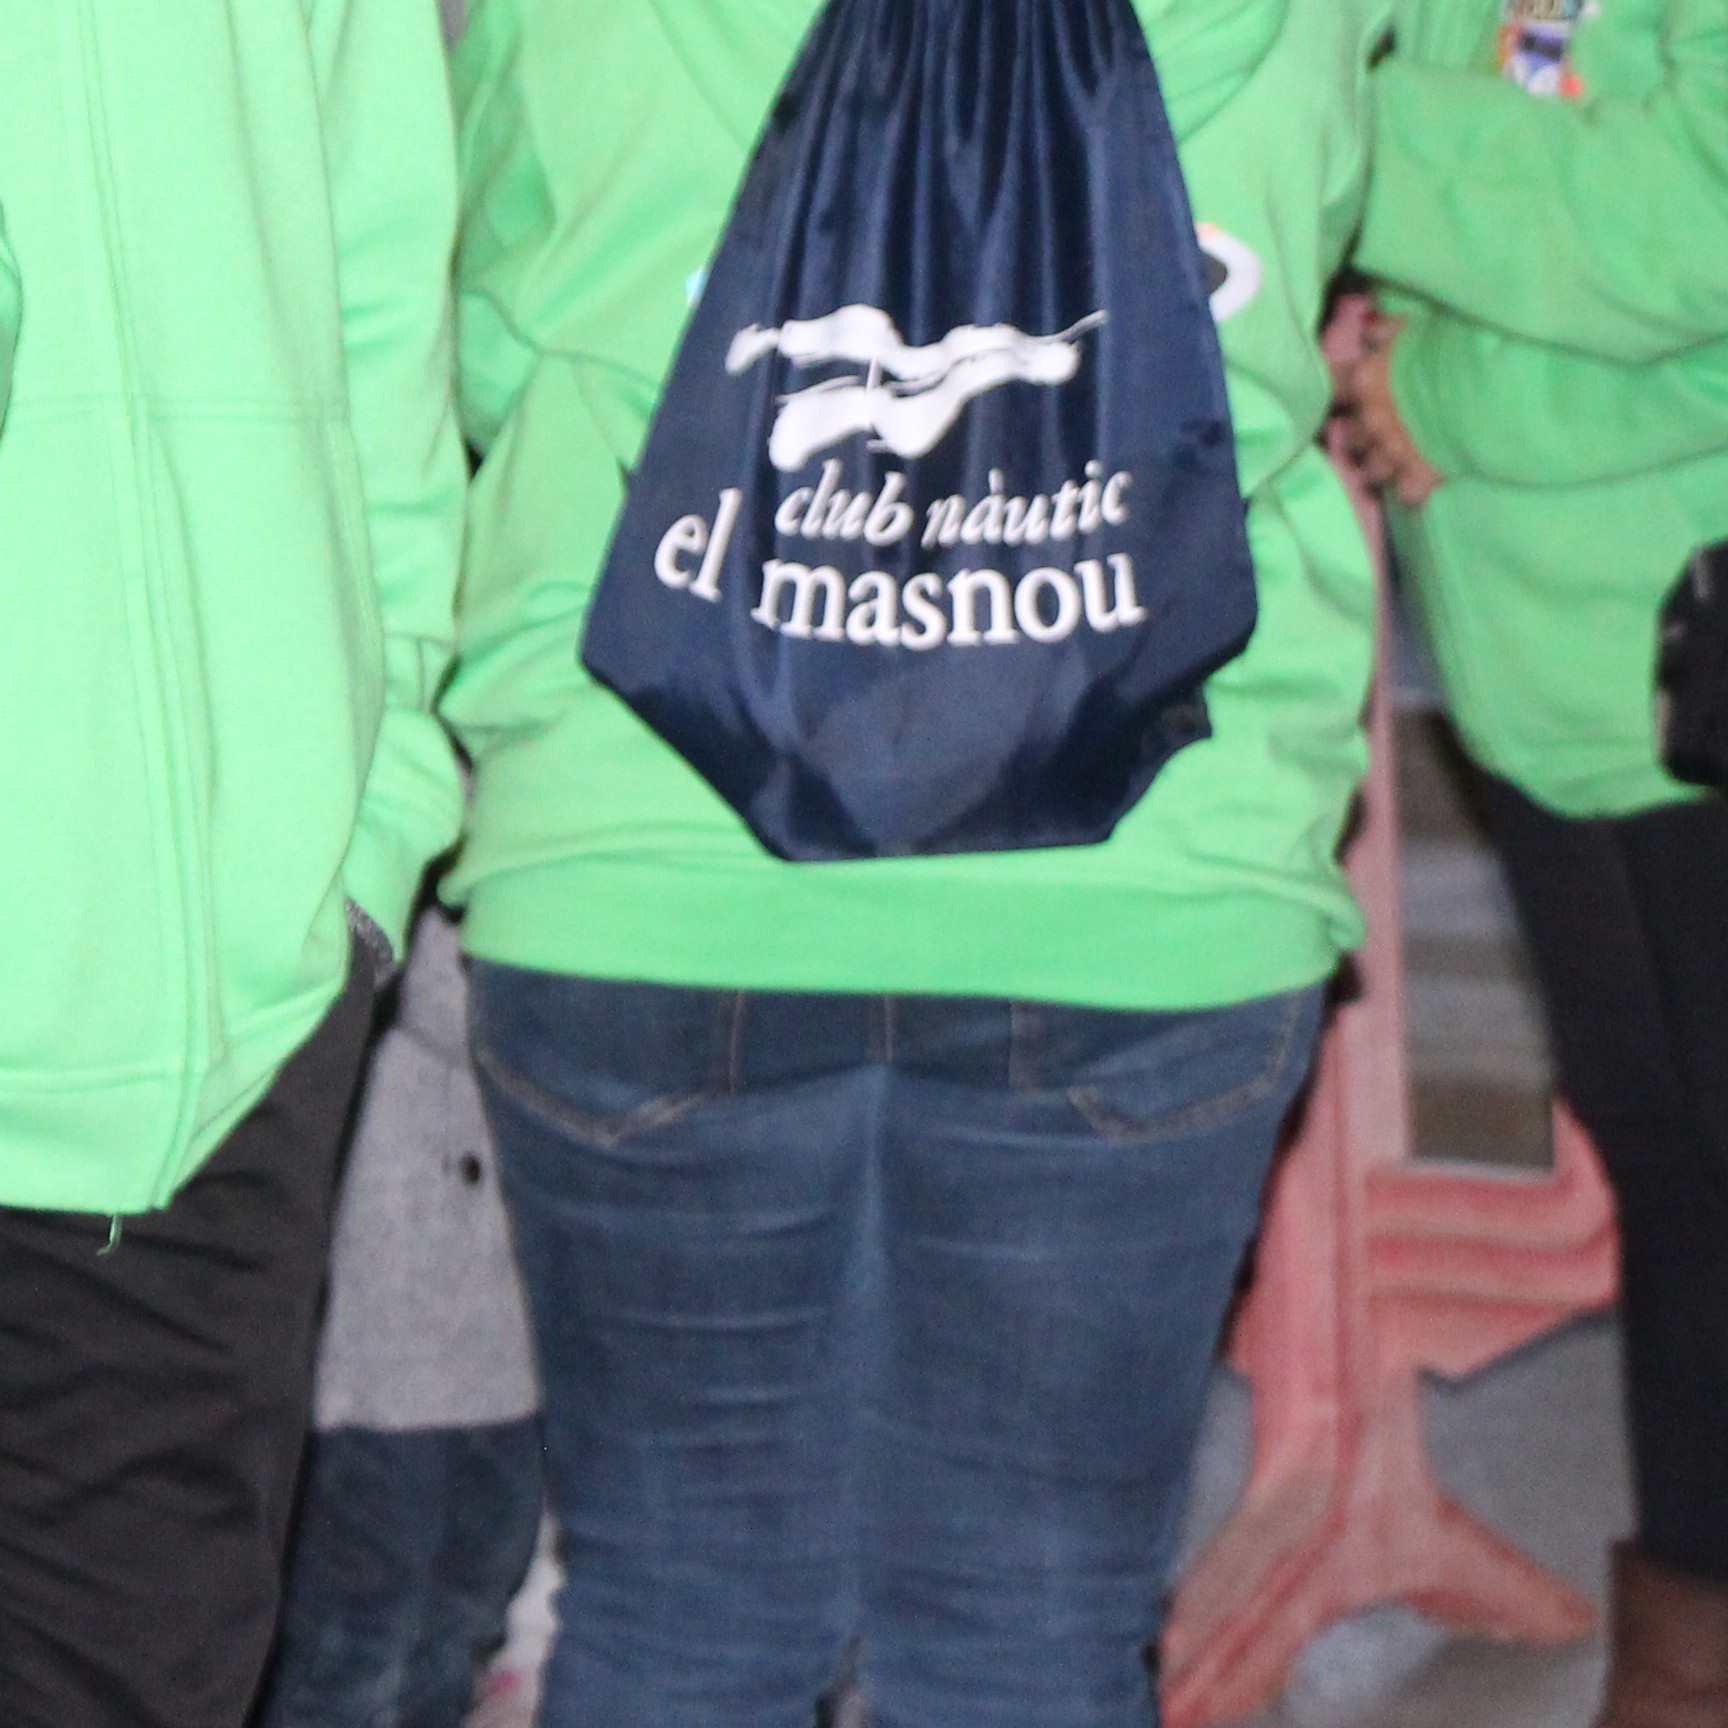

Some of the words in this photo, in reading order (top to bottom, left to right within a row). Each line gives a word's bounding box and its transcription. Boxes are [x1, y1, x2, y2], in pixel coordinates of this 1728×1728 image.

[775, 459, 914, 546] club
[653, 487, 743, 602] el
[751, 553, 1149, 651] masnou
